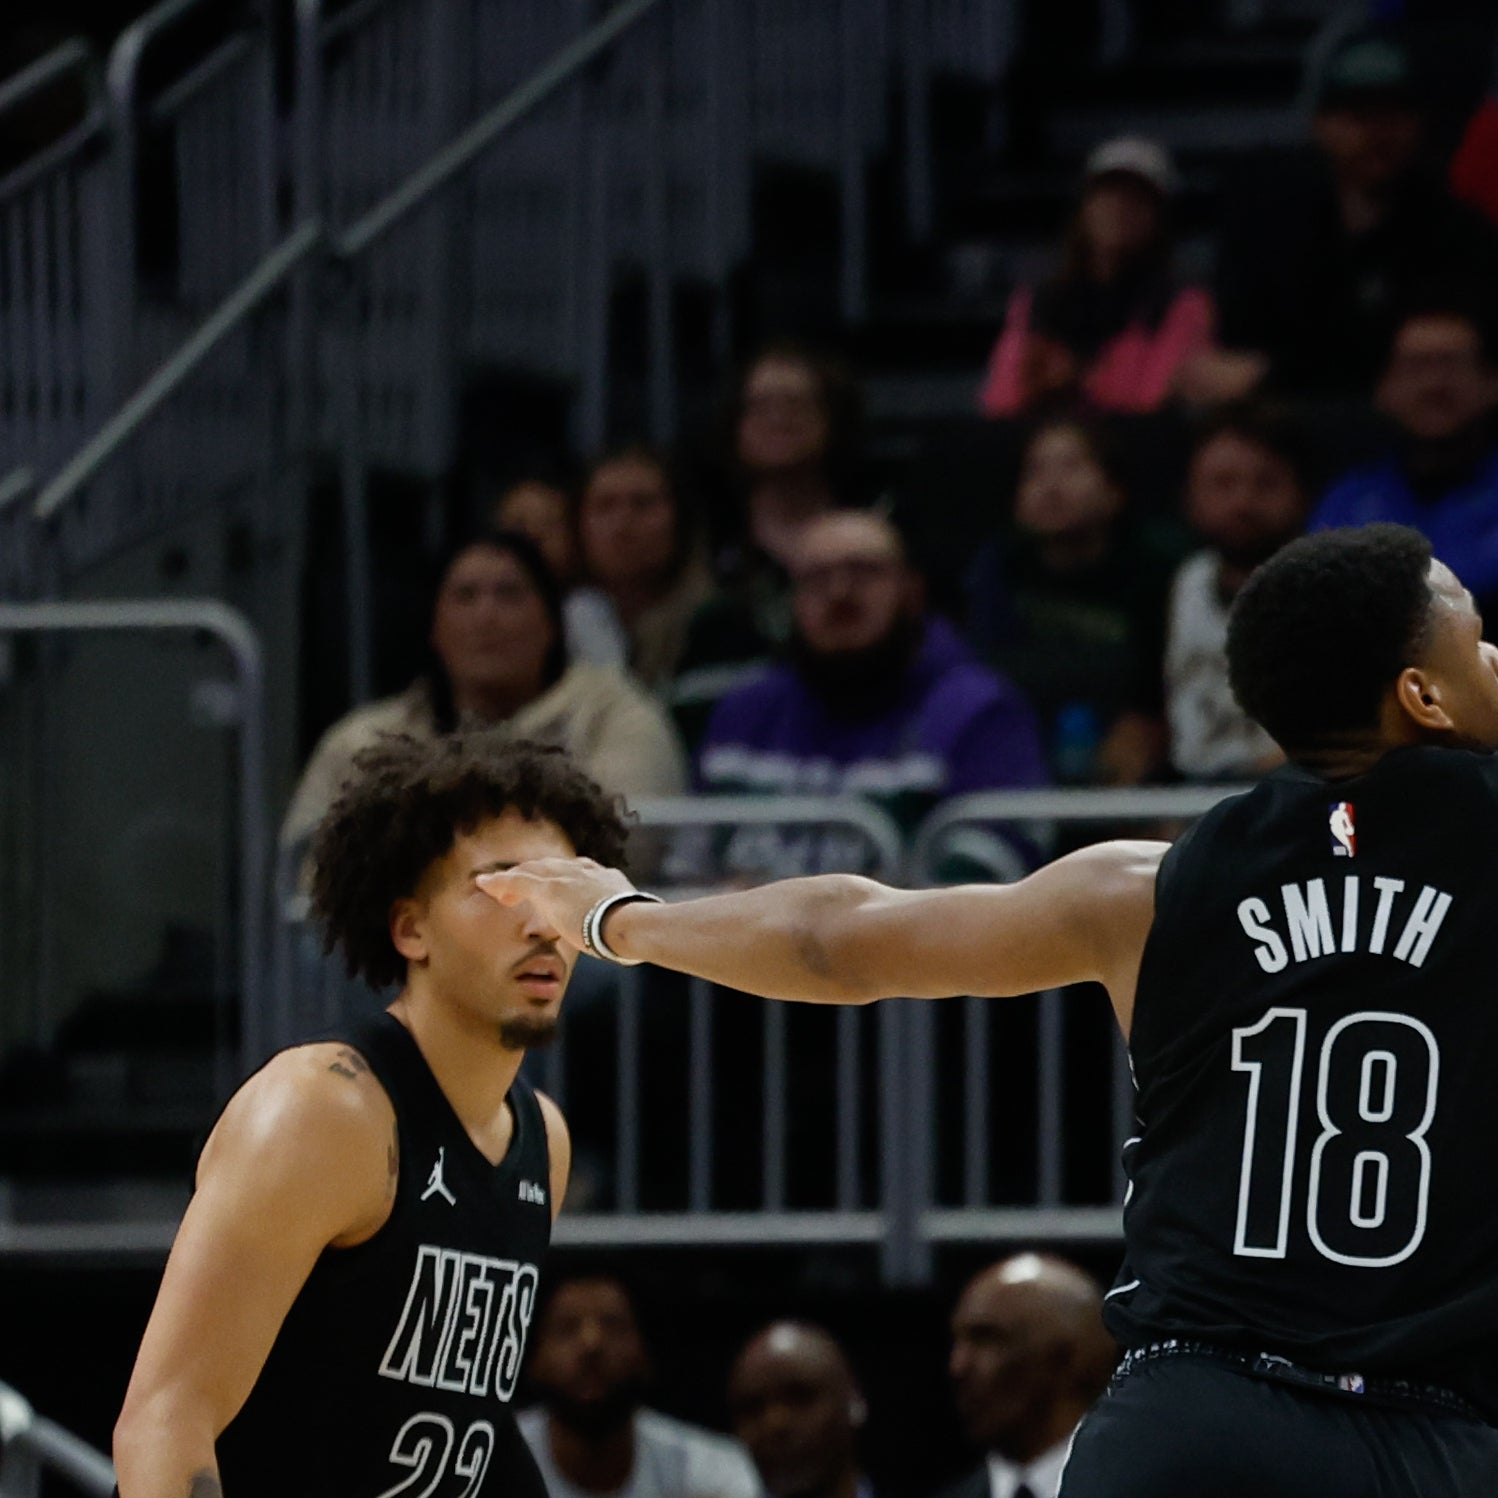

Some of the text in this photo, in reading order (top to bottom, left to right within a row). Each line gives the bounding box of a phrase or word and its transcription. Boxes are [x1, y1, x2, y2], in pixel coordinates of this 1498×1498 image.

[1237, 875, 1453, 974] SMITH
[1231, 1006, 1441, 1268] 18
[377, 1243, 540, 1403] NETS
